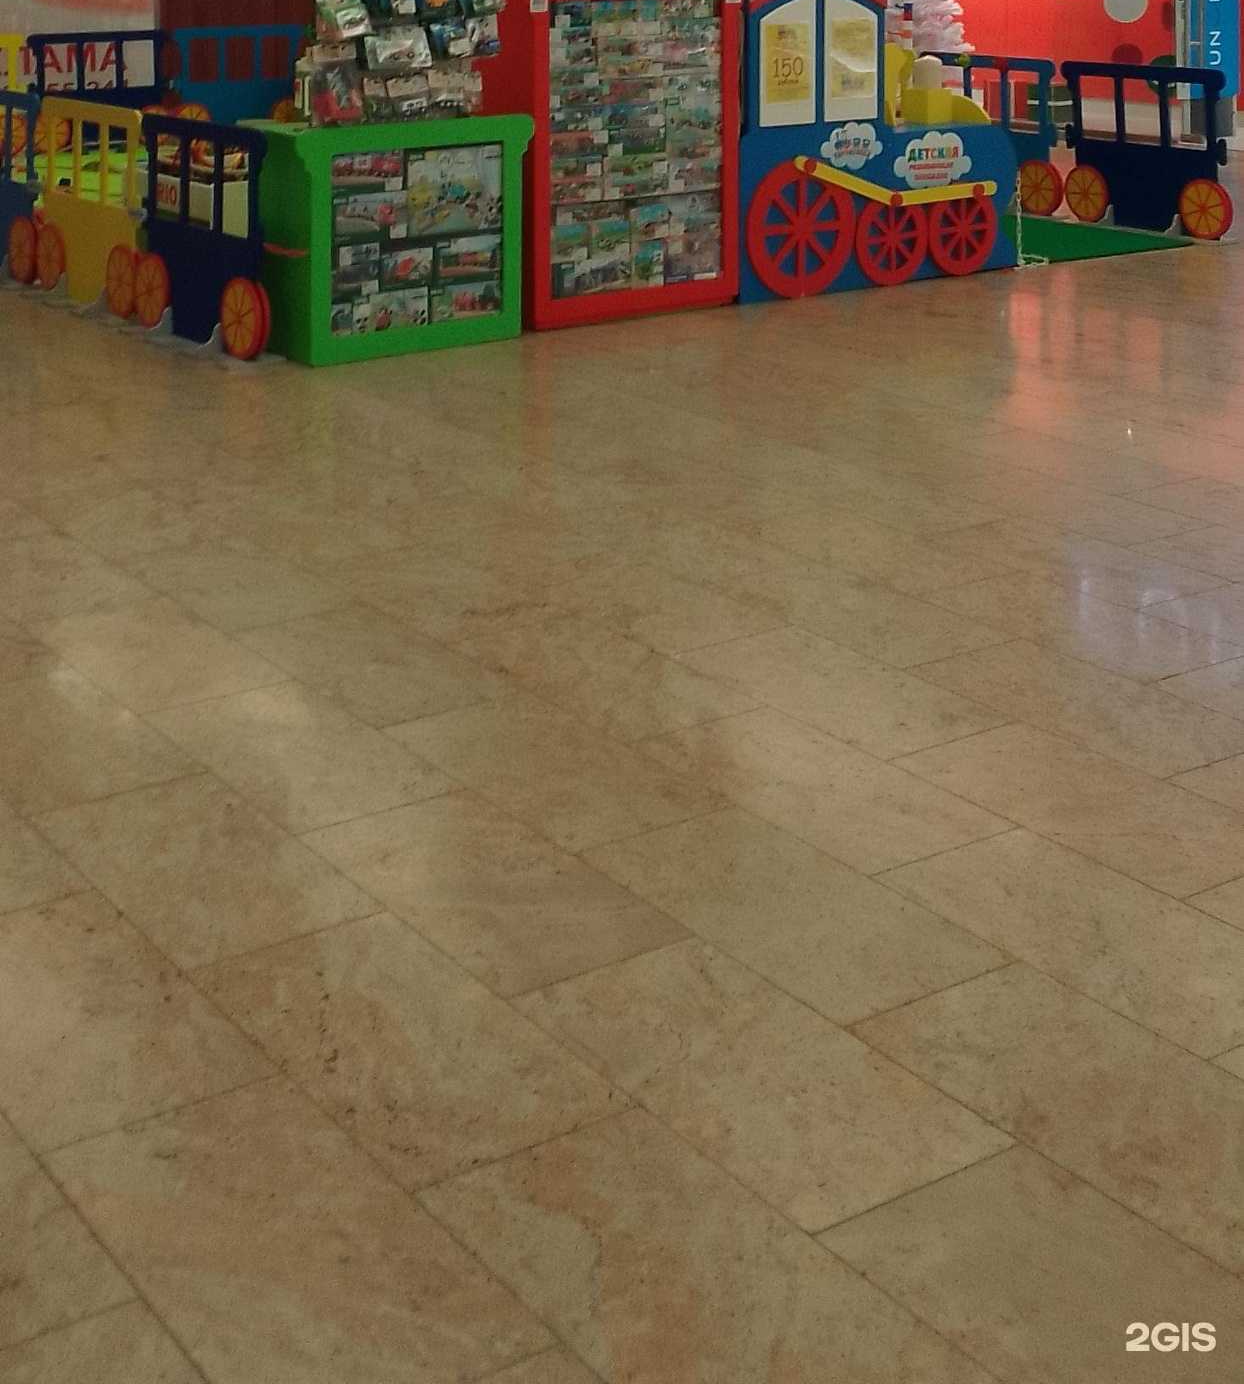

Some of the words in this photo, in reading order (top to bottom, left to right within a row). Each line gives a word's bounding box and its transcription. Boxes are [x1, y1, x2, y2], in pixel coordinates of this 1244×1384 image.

[1209, 30, 1222, 66] UN
[773, 56, 804, 78] 150
[907, 146, 960, 163] ДЕТСКАЯ
